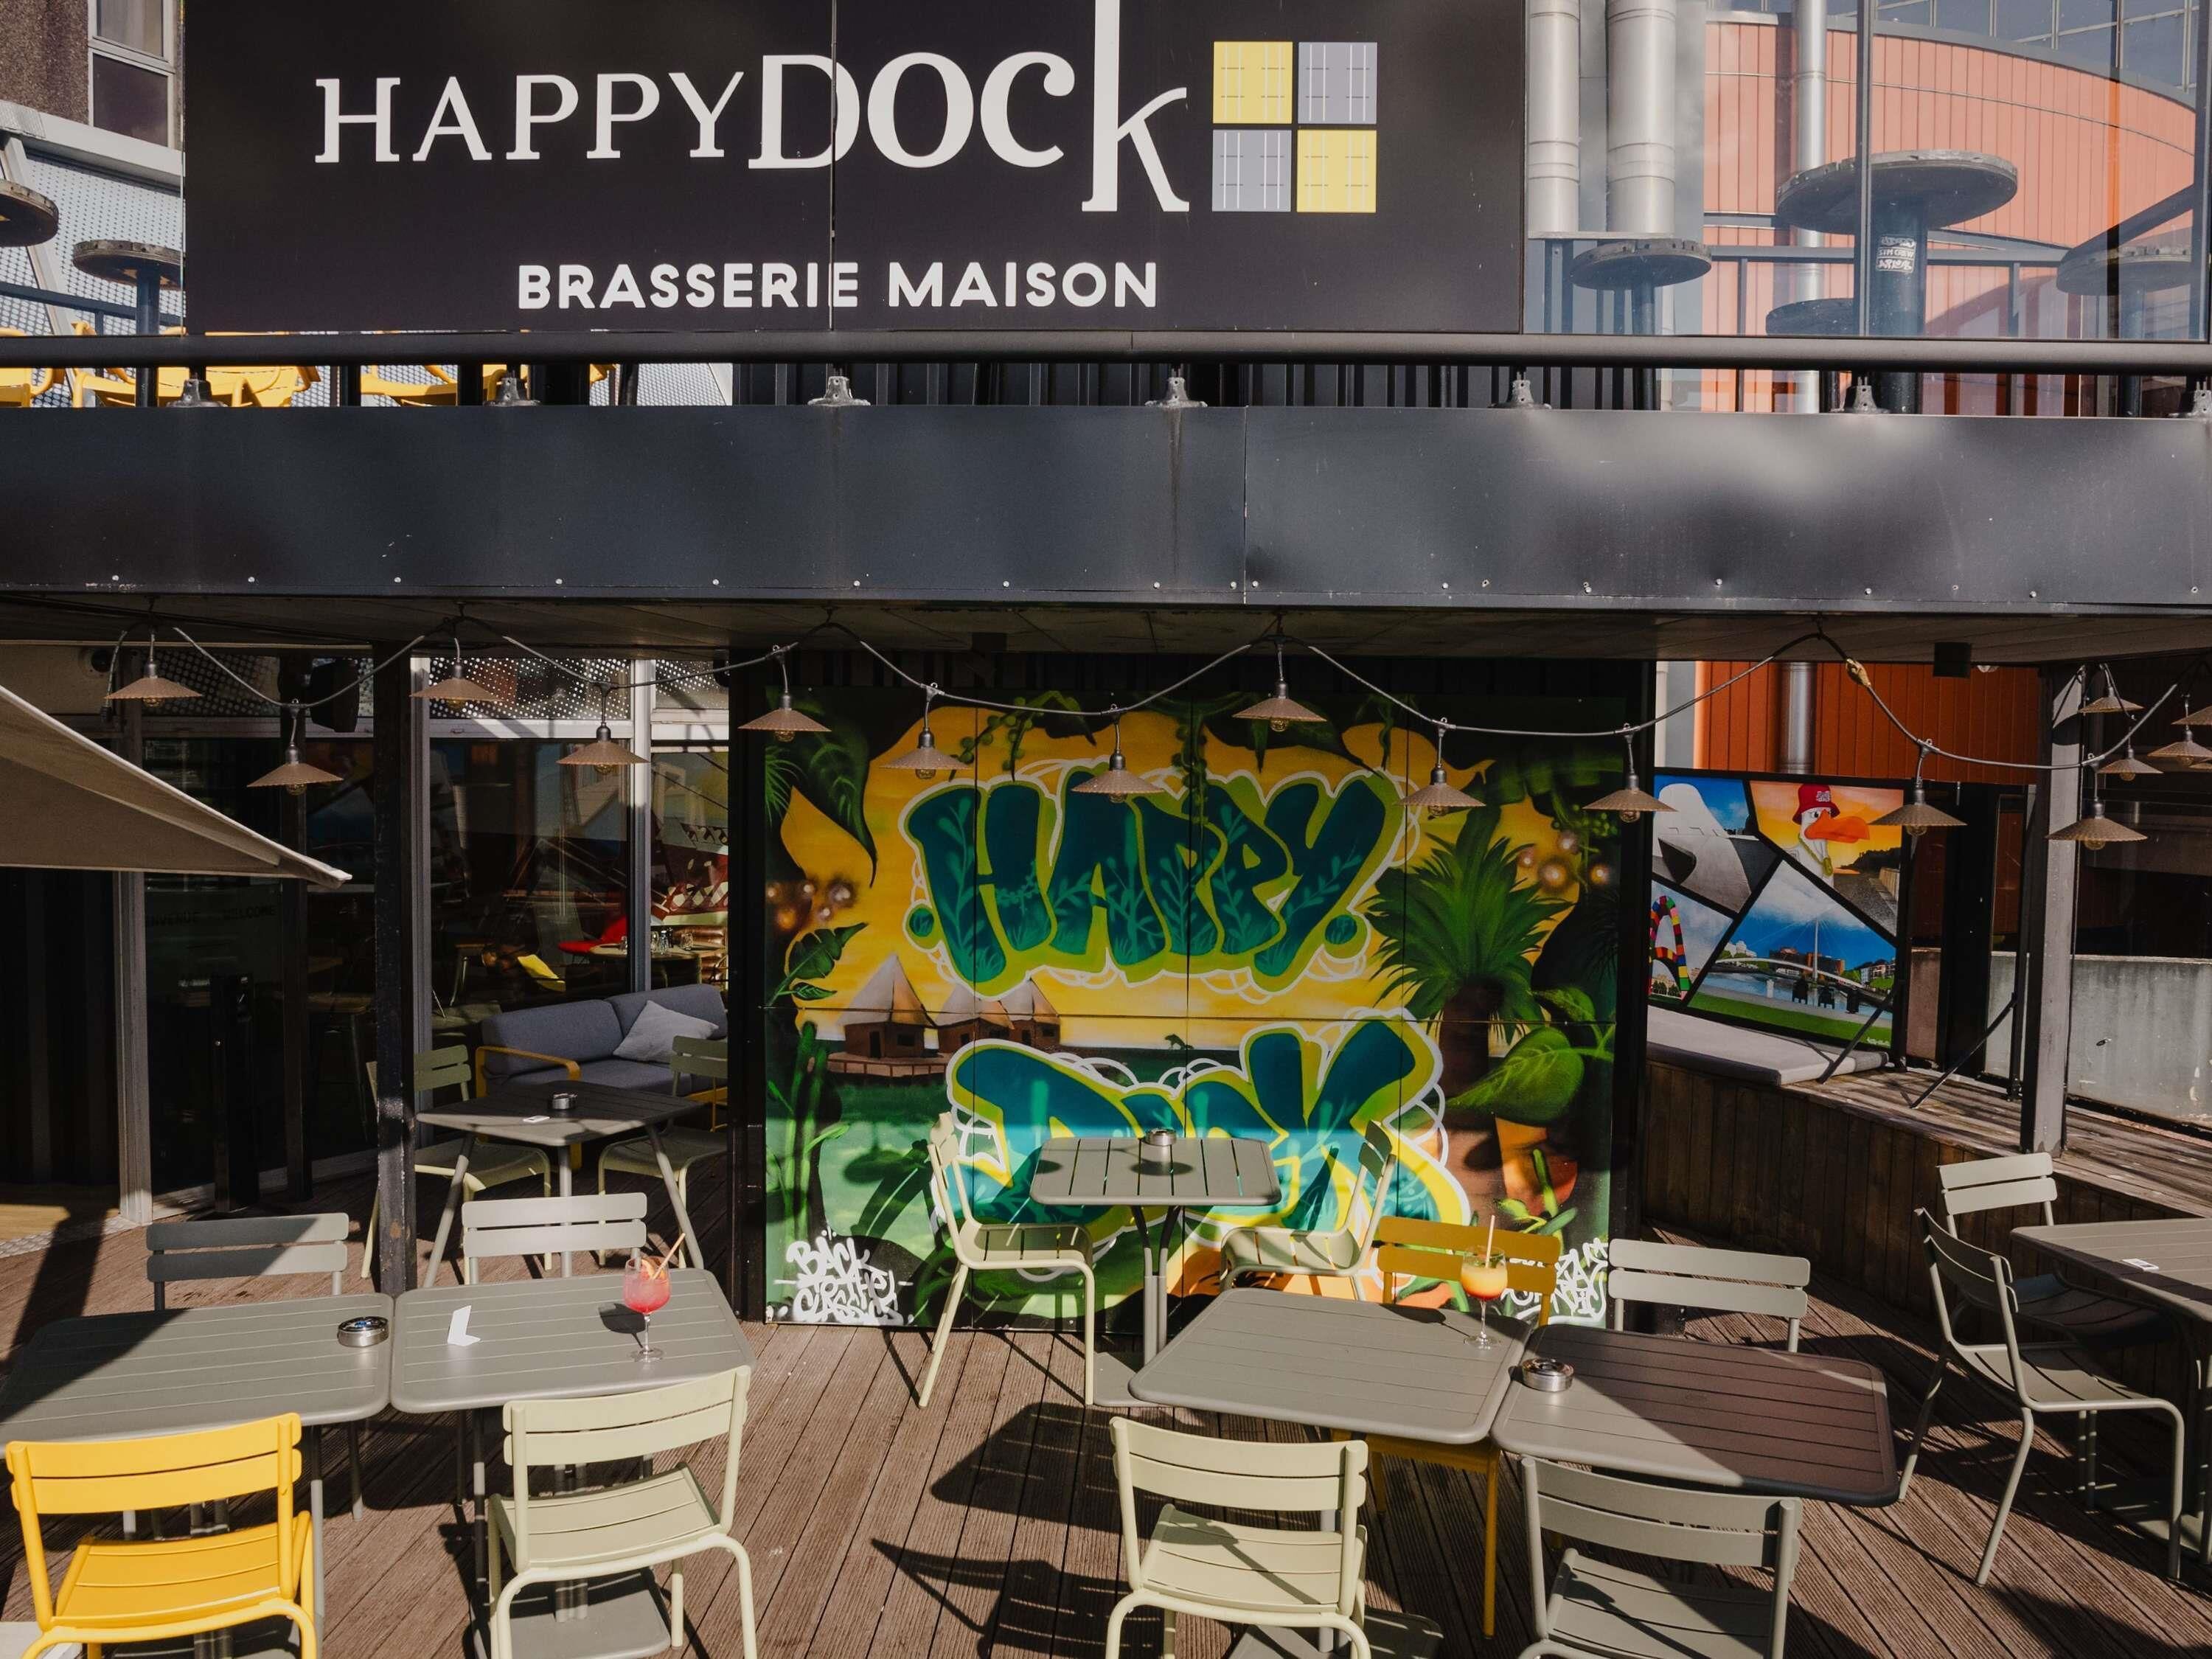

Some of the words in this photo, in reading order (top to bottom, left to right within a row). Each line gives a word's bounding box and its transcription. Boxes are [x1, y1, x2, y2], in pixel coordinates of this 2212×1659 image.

[518, 262, 859, 310] BRASSERIE
[889, 262, 1156, 308] MAISON
[901, 764, 1405, 994] HAPPY
[786, 1237, 888, 1279] BACK
